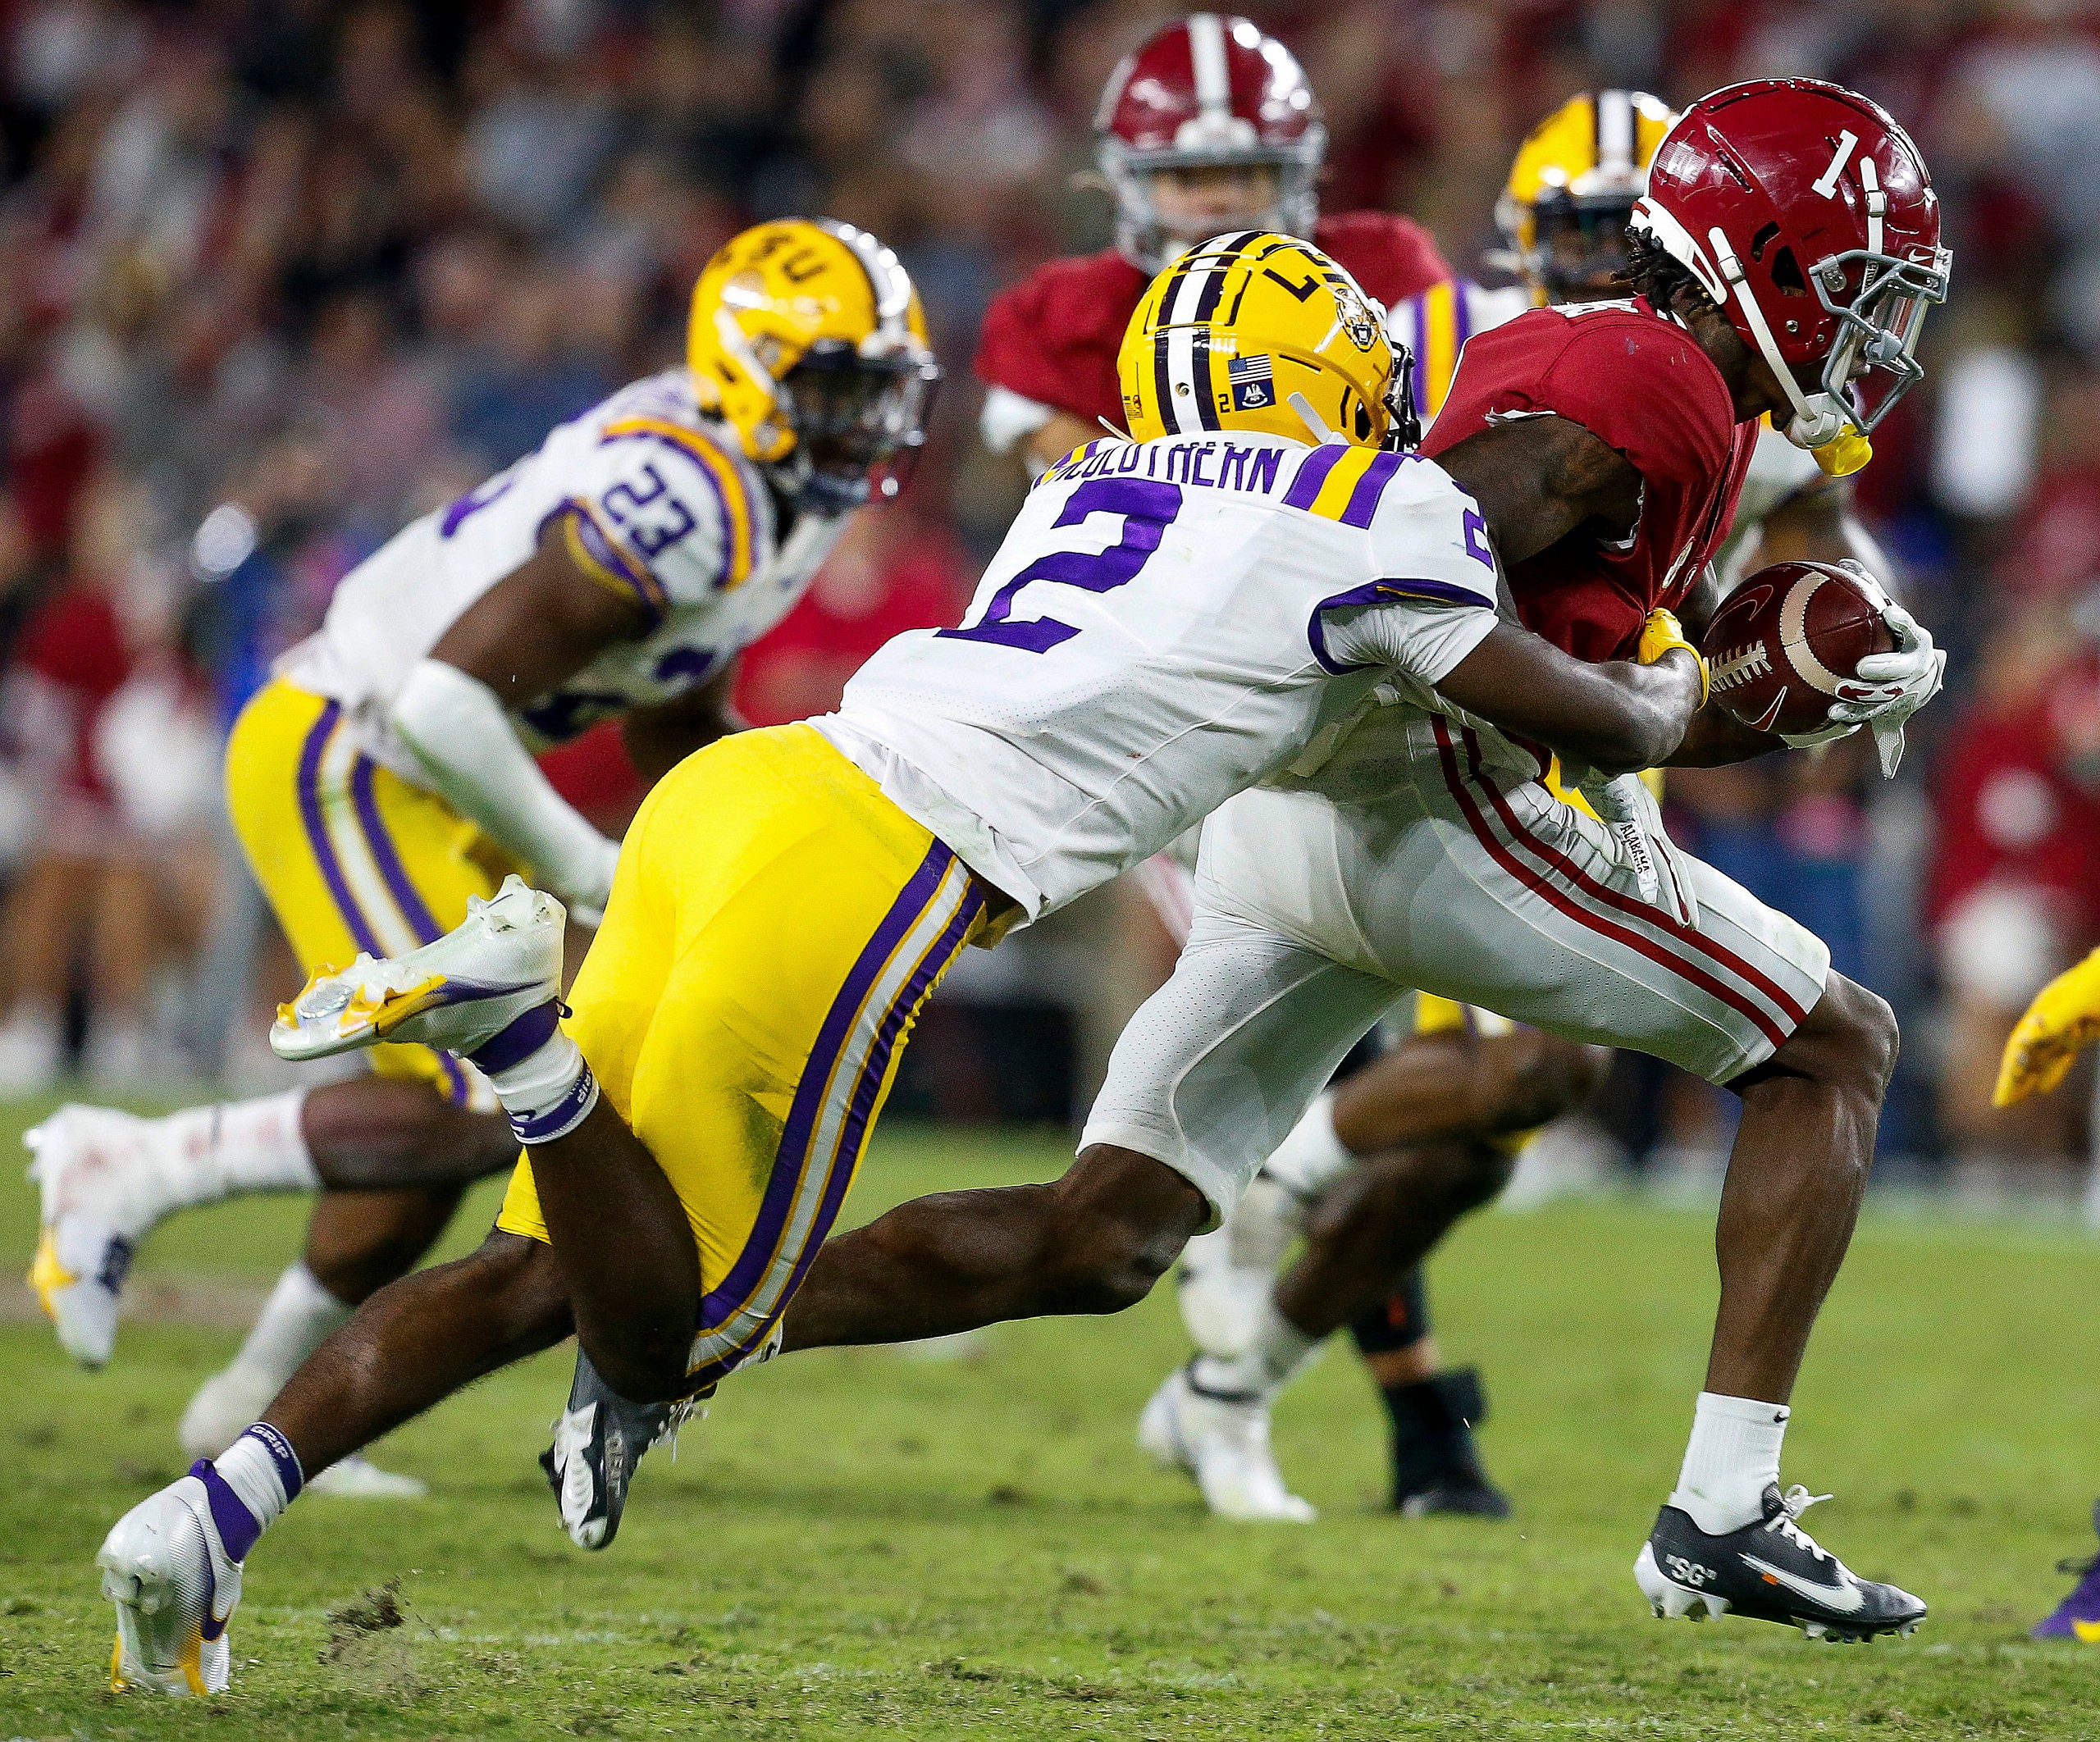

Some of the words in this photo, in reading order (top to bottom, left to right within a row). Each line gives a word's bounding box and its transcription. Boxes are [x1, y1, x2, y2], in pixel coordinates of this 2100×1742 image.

[1811, 129, 1859, 199] 1
[1218, 394, 1231, 413] 2
[601, 463, 696, 559] 23
[1451, 480, 1494, 572] 2
[933, 477, 1183, 654] 2
[1619, 823, 1650, 874] ALABAMA
[249, 1425, 290, 1460] GRIP
